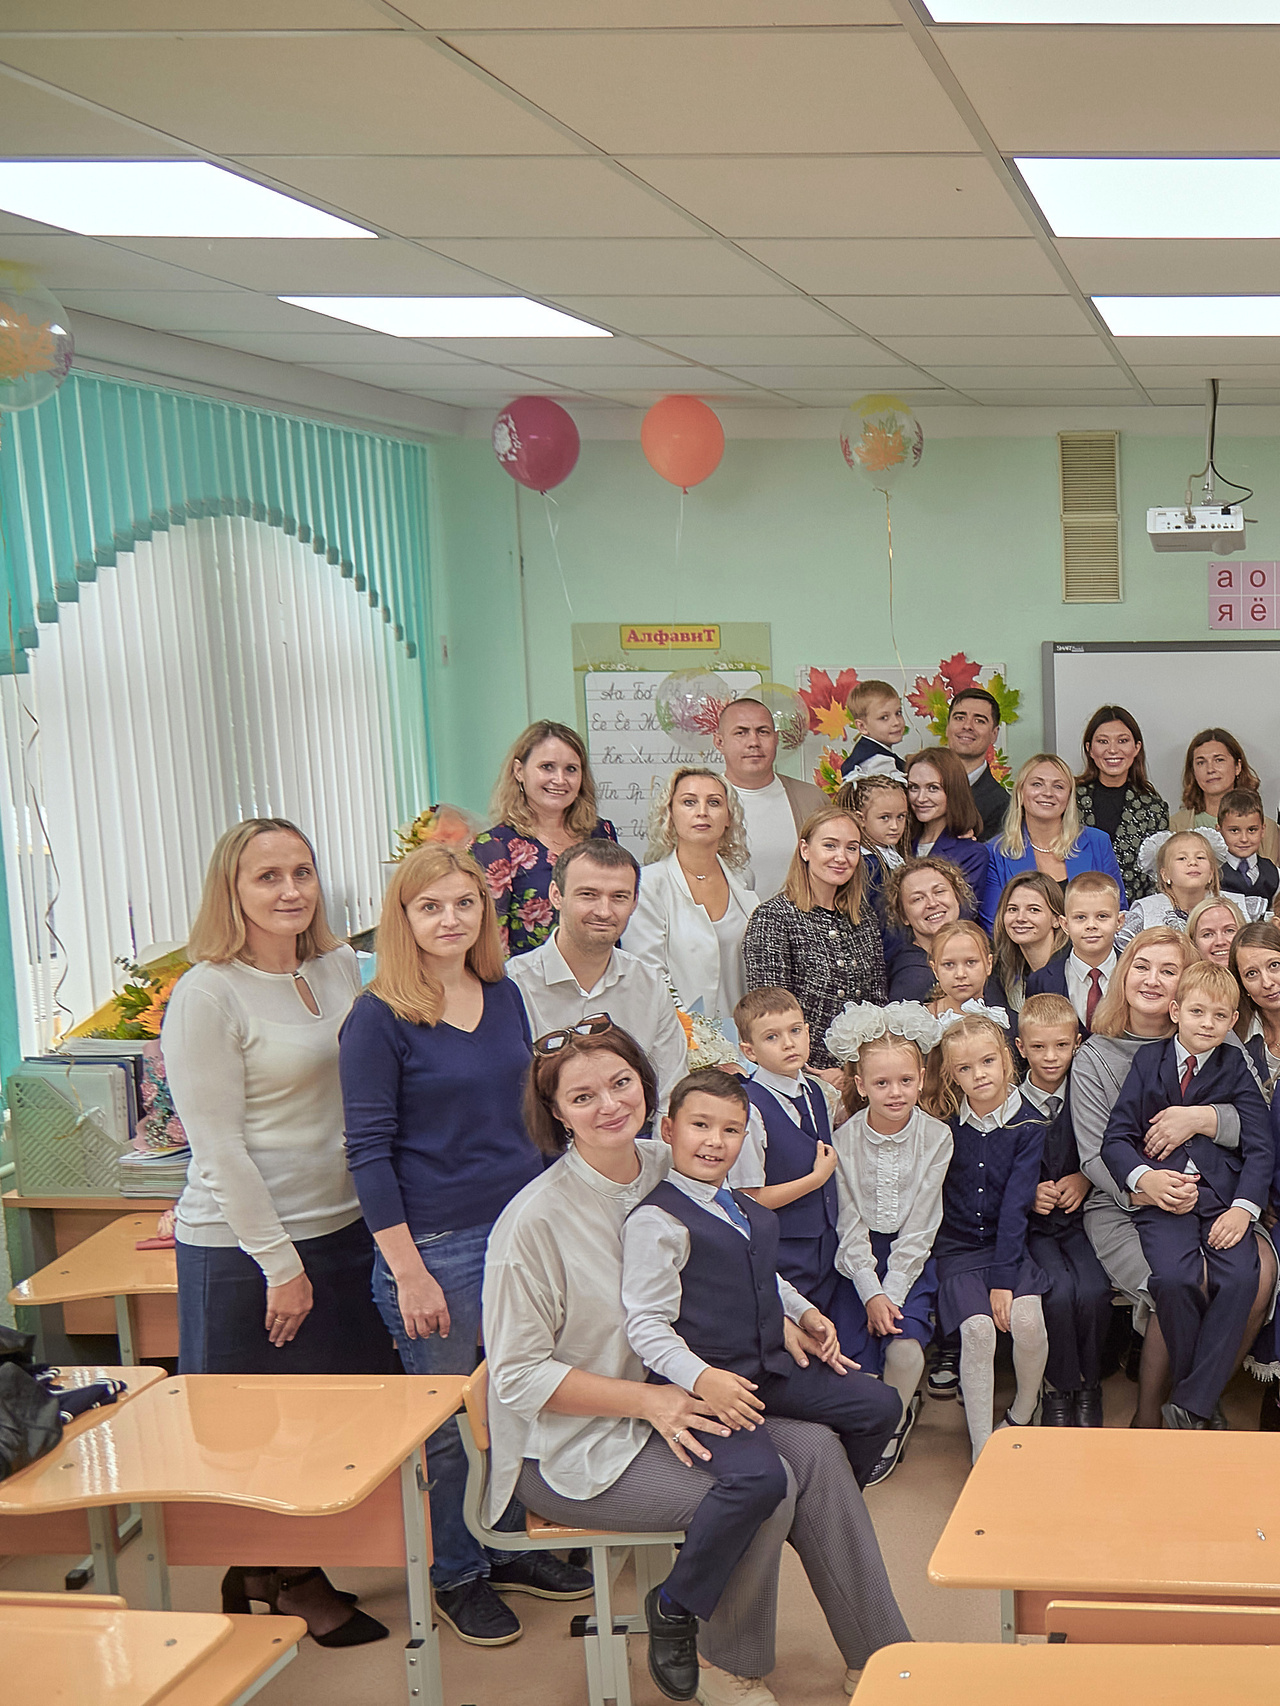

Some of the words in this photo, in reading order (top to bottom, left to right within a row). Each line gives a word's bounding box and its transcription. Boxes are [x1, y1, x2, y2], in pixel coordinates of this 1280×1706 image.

[1217, 570, 1233, 588] а
[1249, 570, 1266, 588] о
[1218, 604, 1233, 621] я
[1250, 598, 1267, 621] ё
